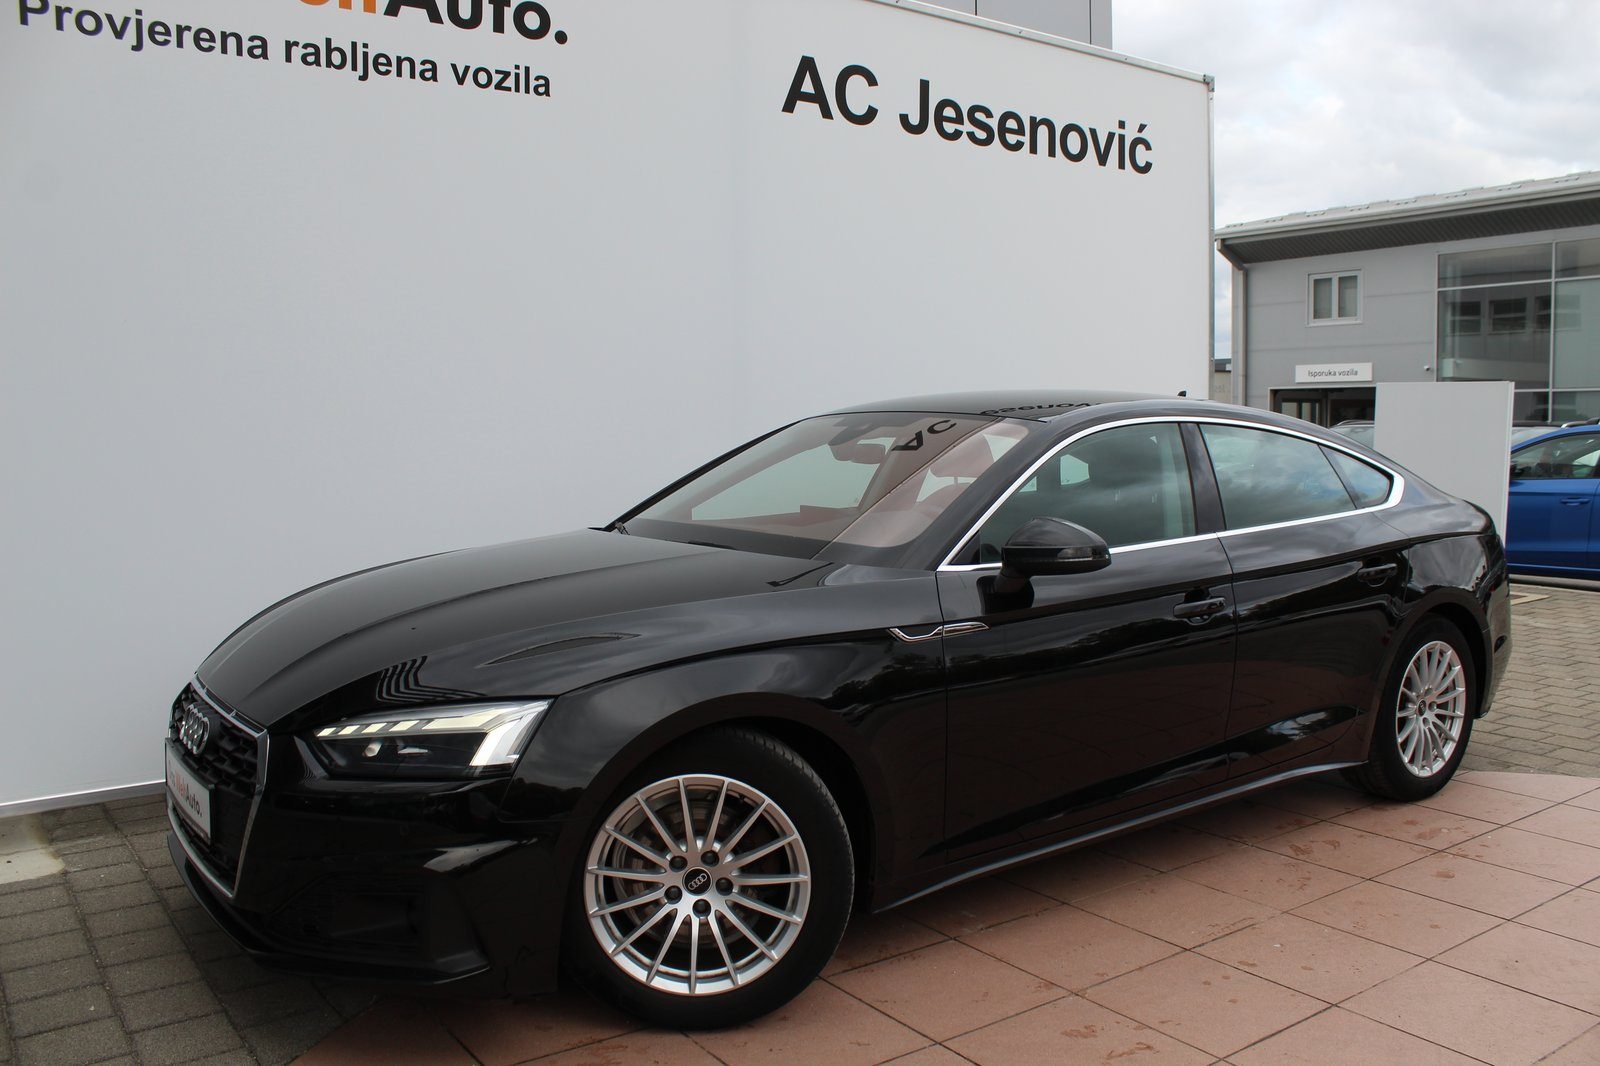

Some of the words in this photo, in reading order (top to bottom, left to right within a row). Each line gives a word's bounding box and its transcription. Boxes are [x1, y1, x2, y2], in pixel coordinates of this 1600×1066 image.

[19, 0, 269, 60] Provjerena
[285, 40, 439, 82] rabljena
[450, 63, 551, 98] vozila
[782, 56, 879, 126] AC
[899, 78, 1153, 175] Jesenović
[1308, 369, 1337, 378] Isporuka
[1338, 368, 1358, 376] vozila
